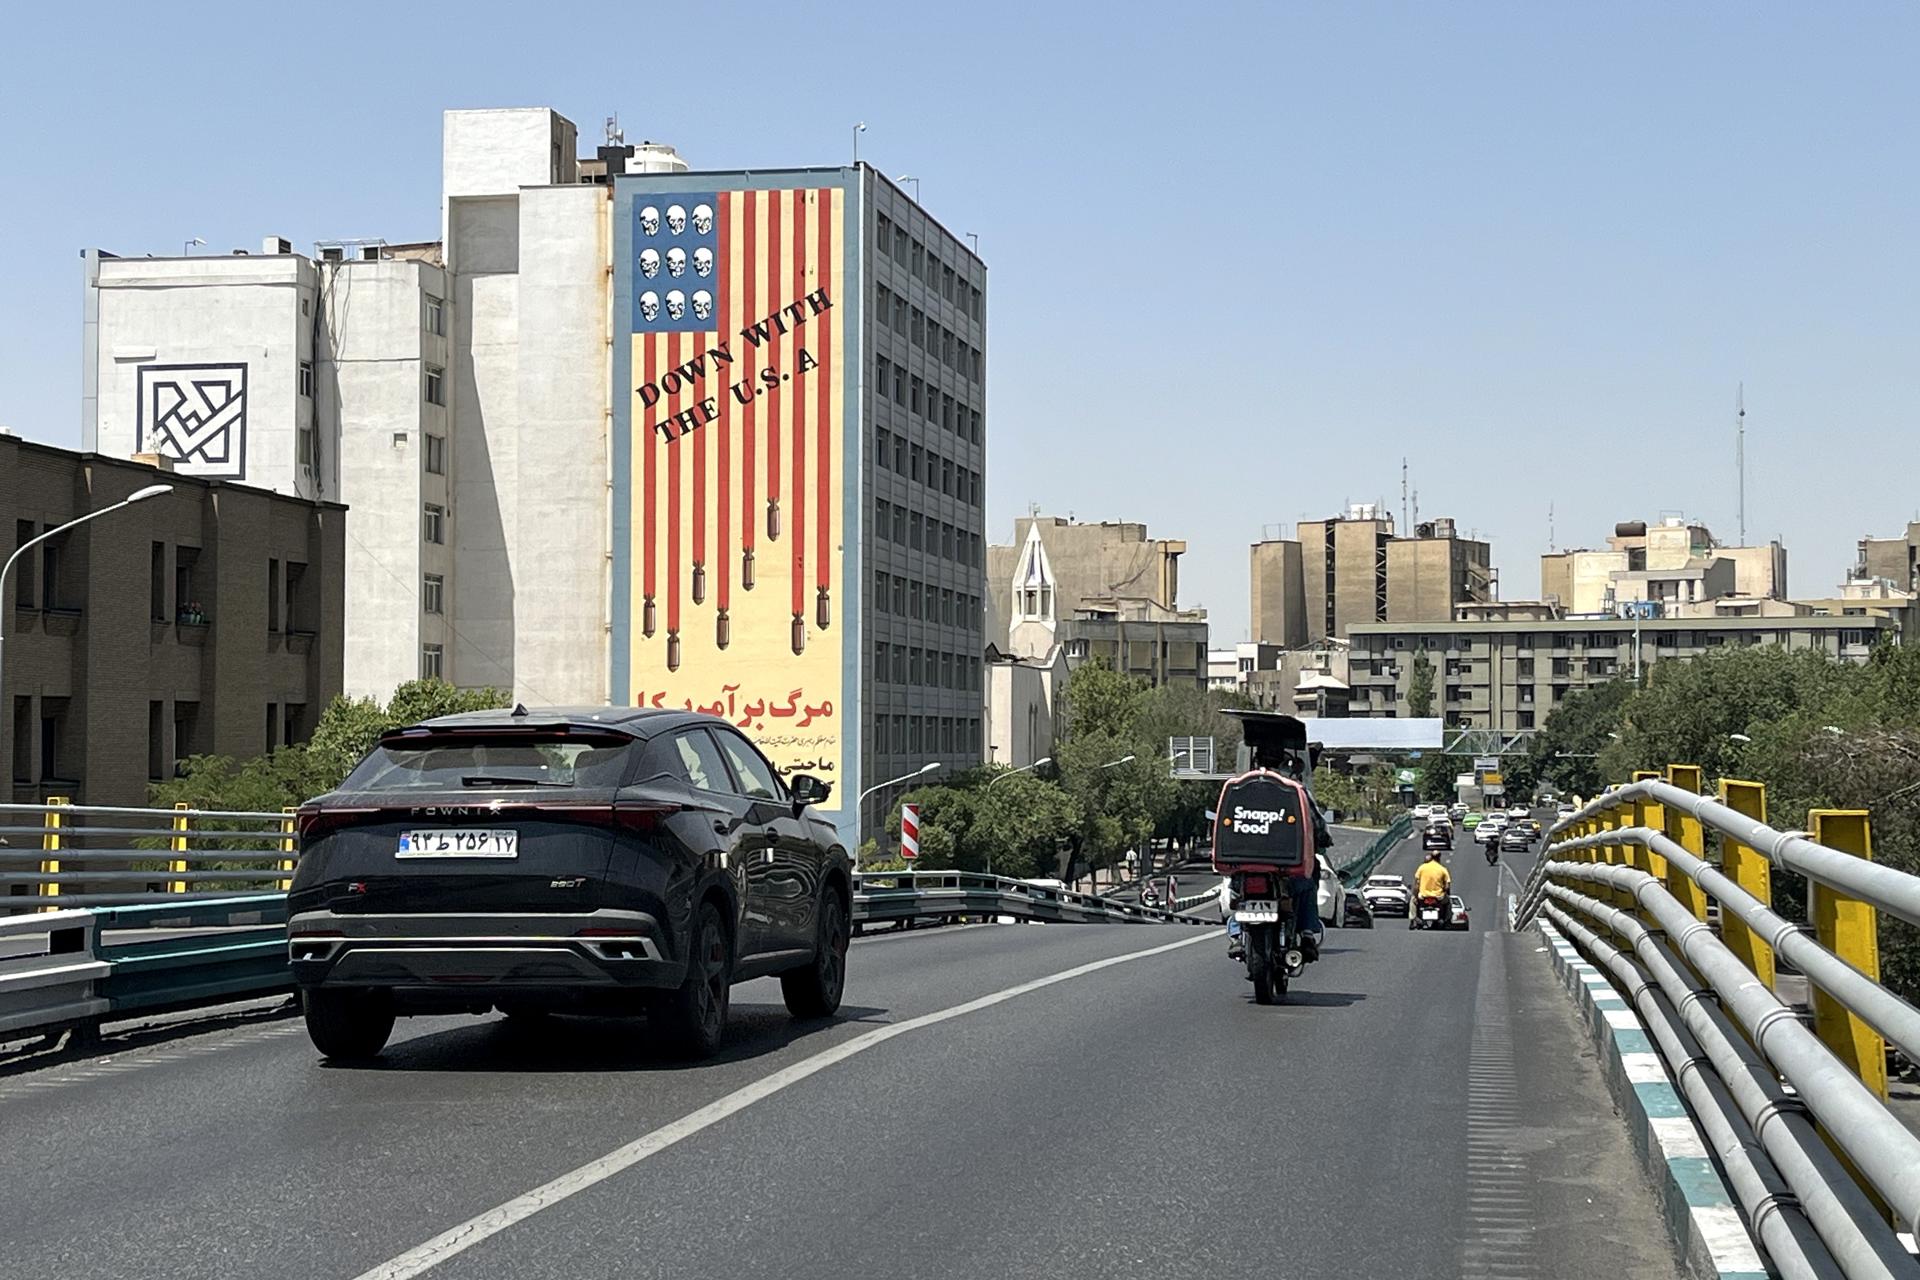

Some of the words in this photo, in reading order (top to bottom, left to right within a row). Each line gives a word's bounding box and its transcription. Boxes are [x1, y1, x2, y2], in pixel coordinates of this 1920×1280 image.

[635, 342, 734, 410] DOWN
[740, 287, 834, 348] WITH
[654, 396, 721, 444] THE
[737, 698, 765, 731] بر
[769, 688, 833, 727] مرگ
[778, 758, 817, 776] حتی
[818, 756, 835, 771] ما
[1234, 806, 1285, 823] Snapp!
[1234, 820, 1269, 834] Food
